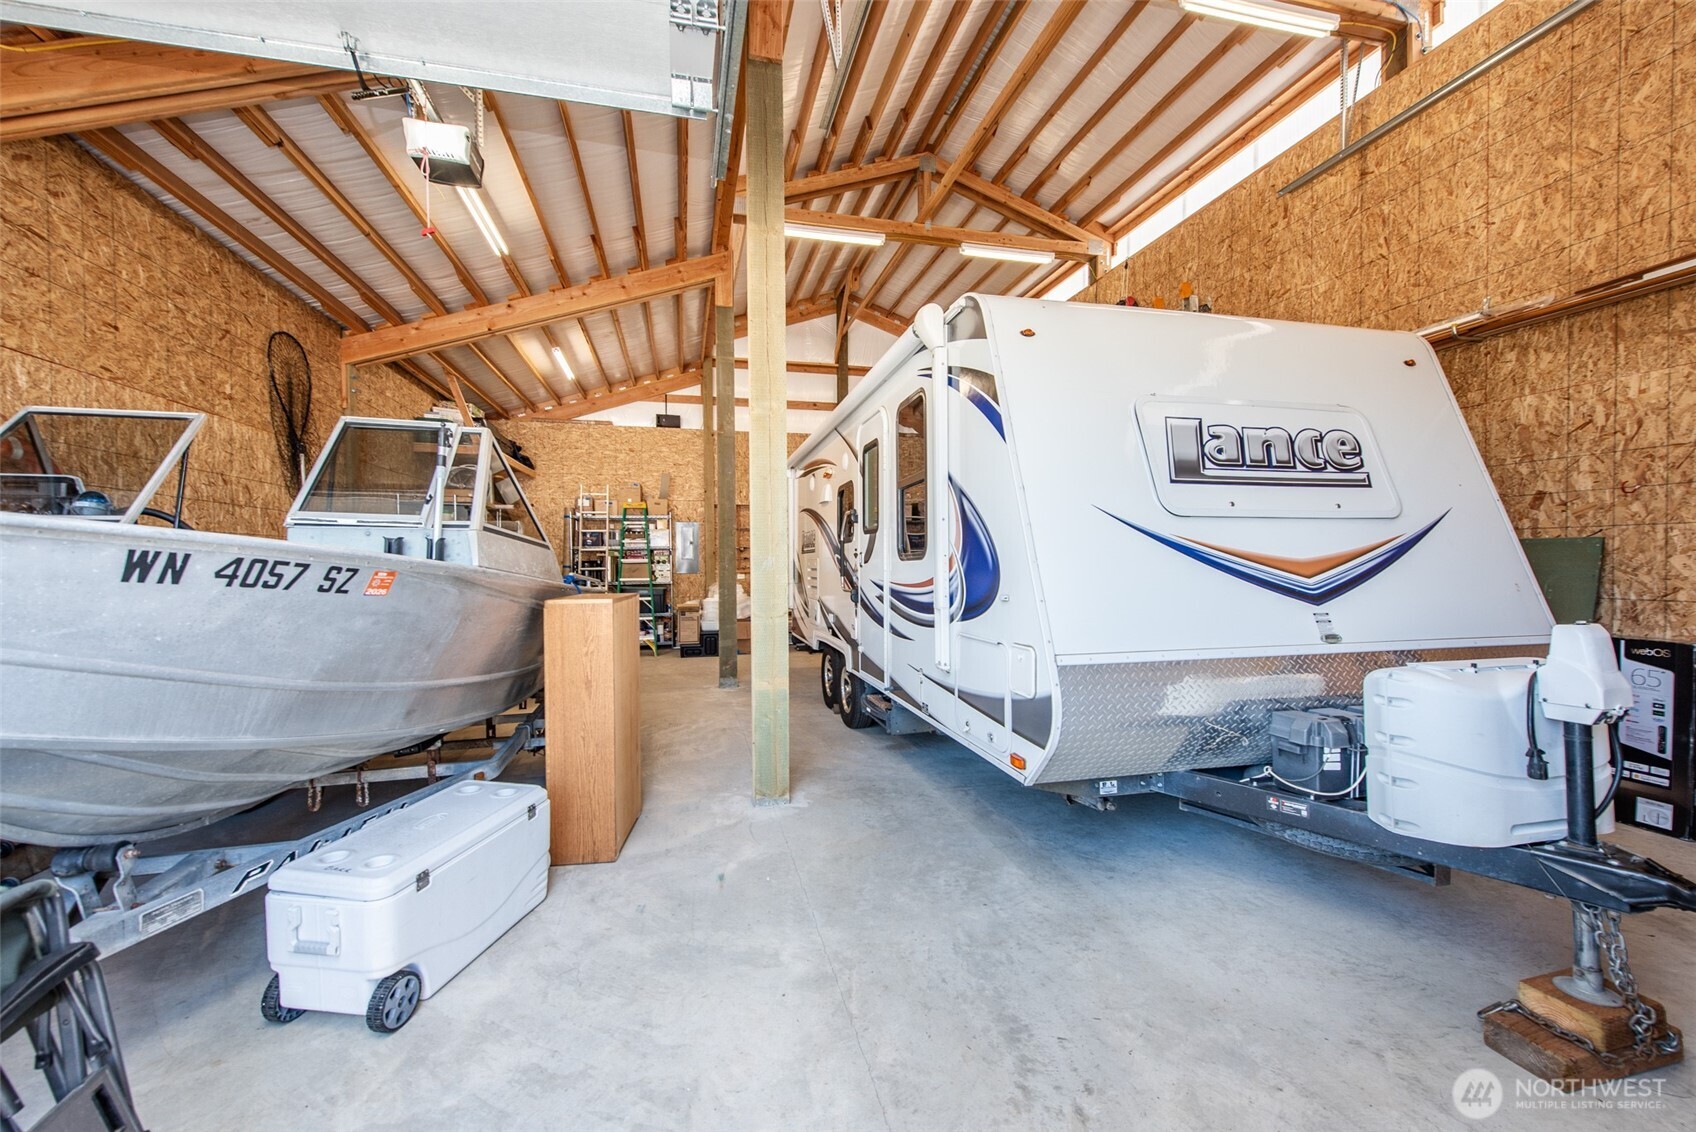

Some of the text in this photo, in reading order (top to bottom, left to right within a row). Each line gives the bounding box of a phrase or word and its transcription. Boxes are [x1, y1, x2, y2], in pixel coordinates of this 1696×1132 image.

[1165, 416, 1372, 488] Lance
[121, 549, 192, 585] WN
[214, 557, 311, 590] 4057
[317, 565, 360, 594] SZ
[1631, 648, 1672, 658] webOS
